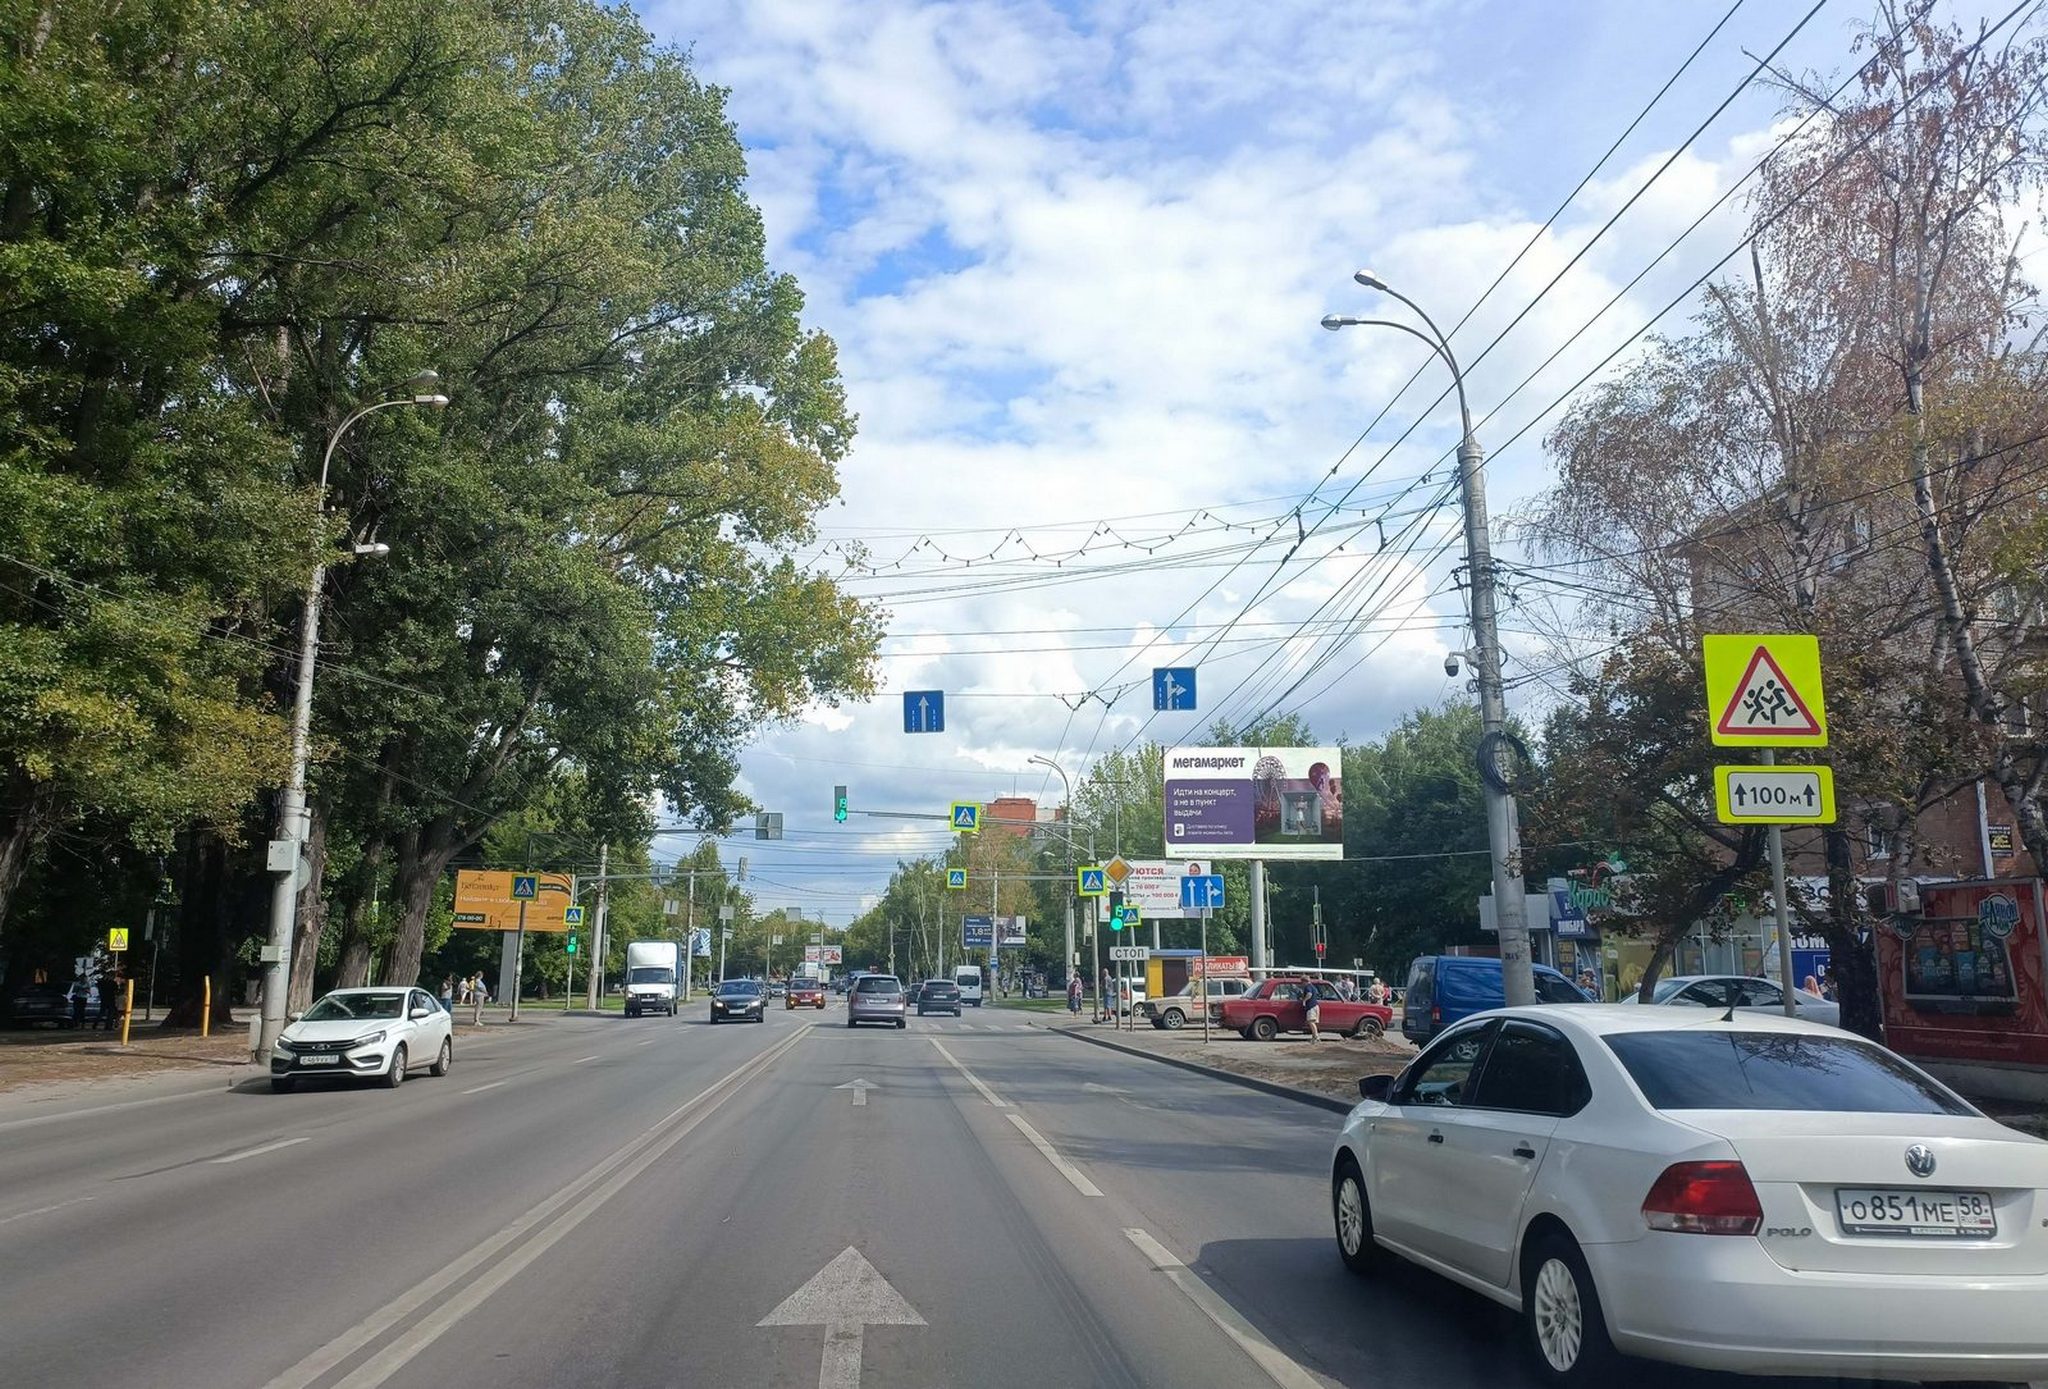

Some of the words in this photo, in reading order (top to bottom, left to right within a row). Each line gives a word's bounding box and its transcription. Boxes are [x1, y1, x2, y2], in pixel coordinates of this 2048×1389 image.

[1173, 757, 1245, 770] мегамаркет
[1173, 788, 1193, 797] Идти
[1204, 788, 1237, 797] концерт,
[1750, 786, 1786, 805] 100
[1195, 799, 1217, 807] пункт
[1173, 809, 1202, 817] выдачи
[1115, 948, 1145, 958] СТОП
[1766, 1227, 1812, 1237] POLO
